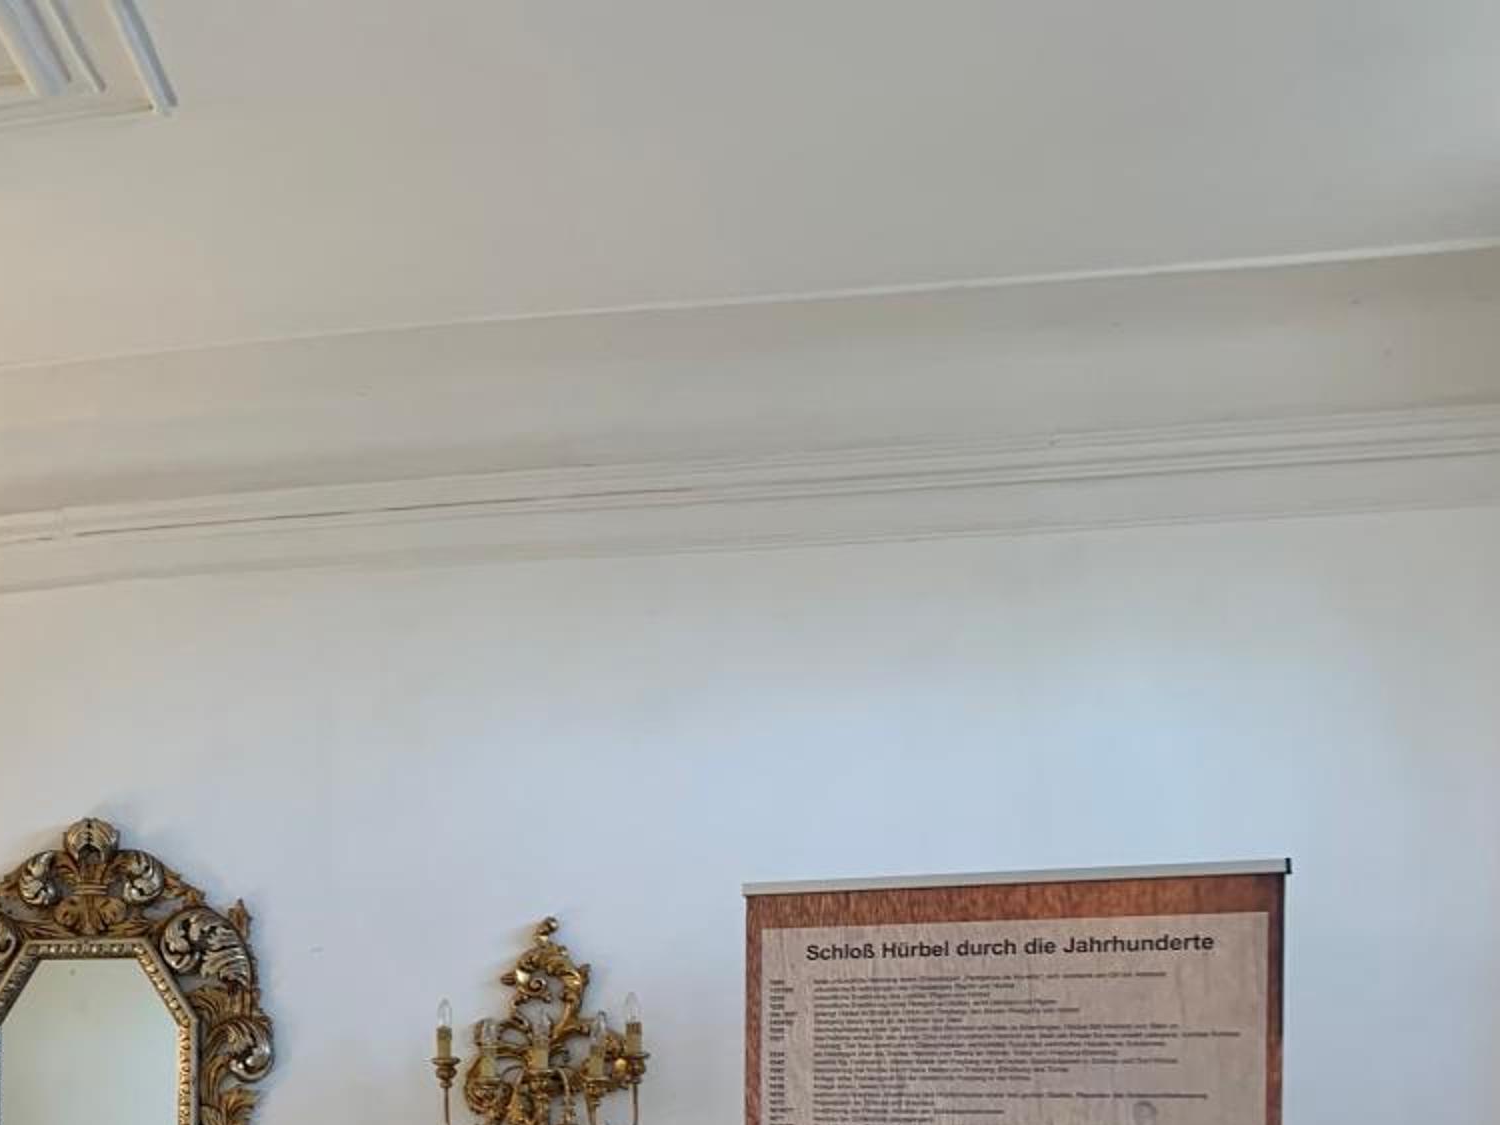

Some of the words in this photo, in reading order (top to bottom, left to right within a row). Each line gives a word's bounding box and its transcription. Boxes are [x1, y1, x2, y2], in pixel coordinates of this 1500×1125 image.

[806, 943, 875, 961] Schloß
[882, 940, 949, 958] Hürbel
[956, 939, 1017, 956] durch
[1024, 937, 1057, 954] die
[1063, 934, 1215, 953] Jahrhunderte
